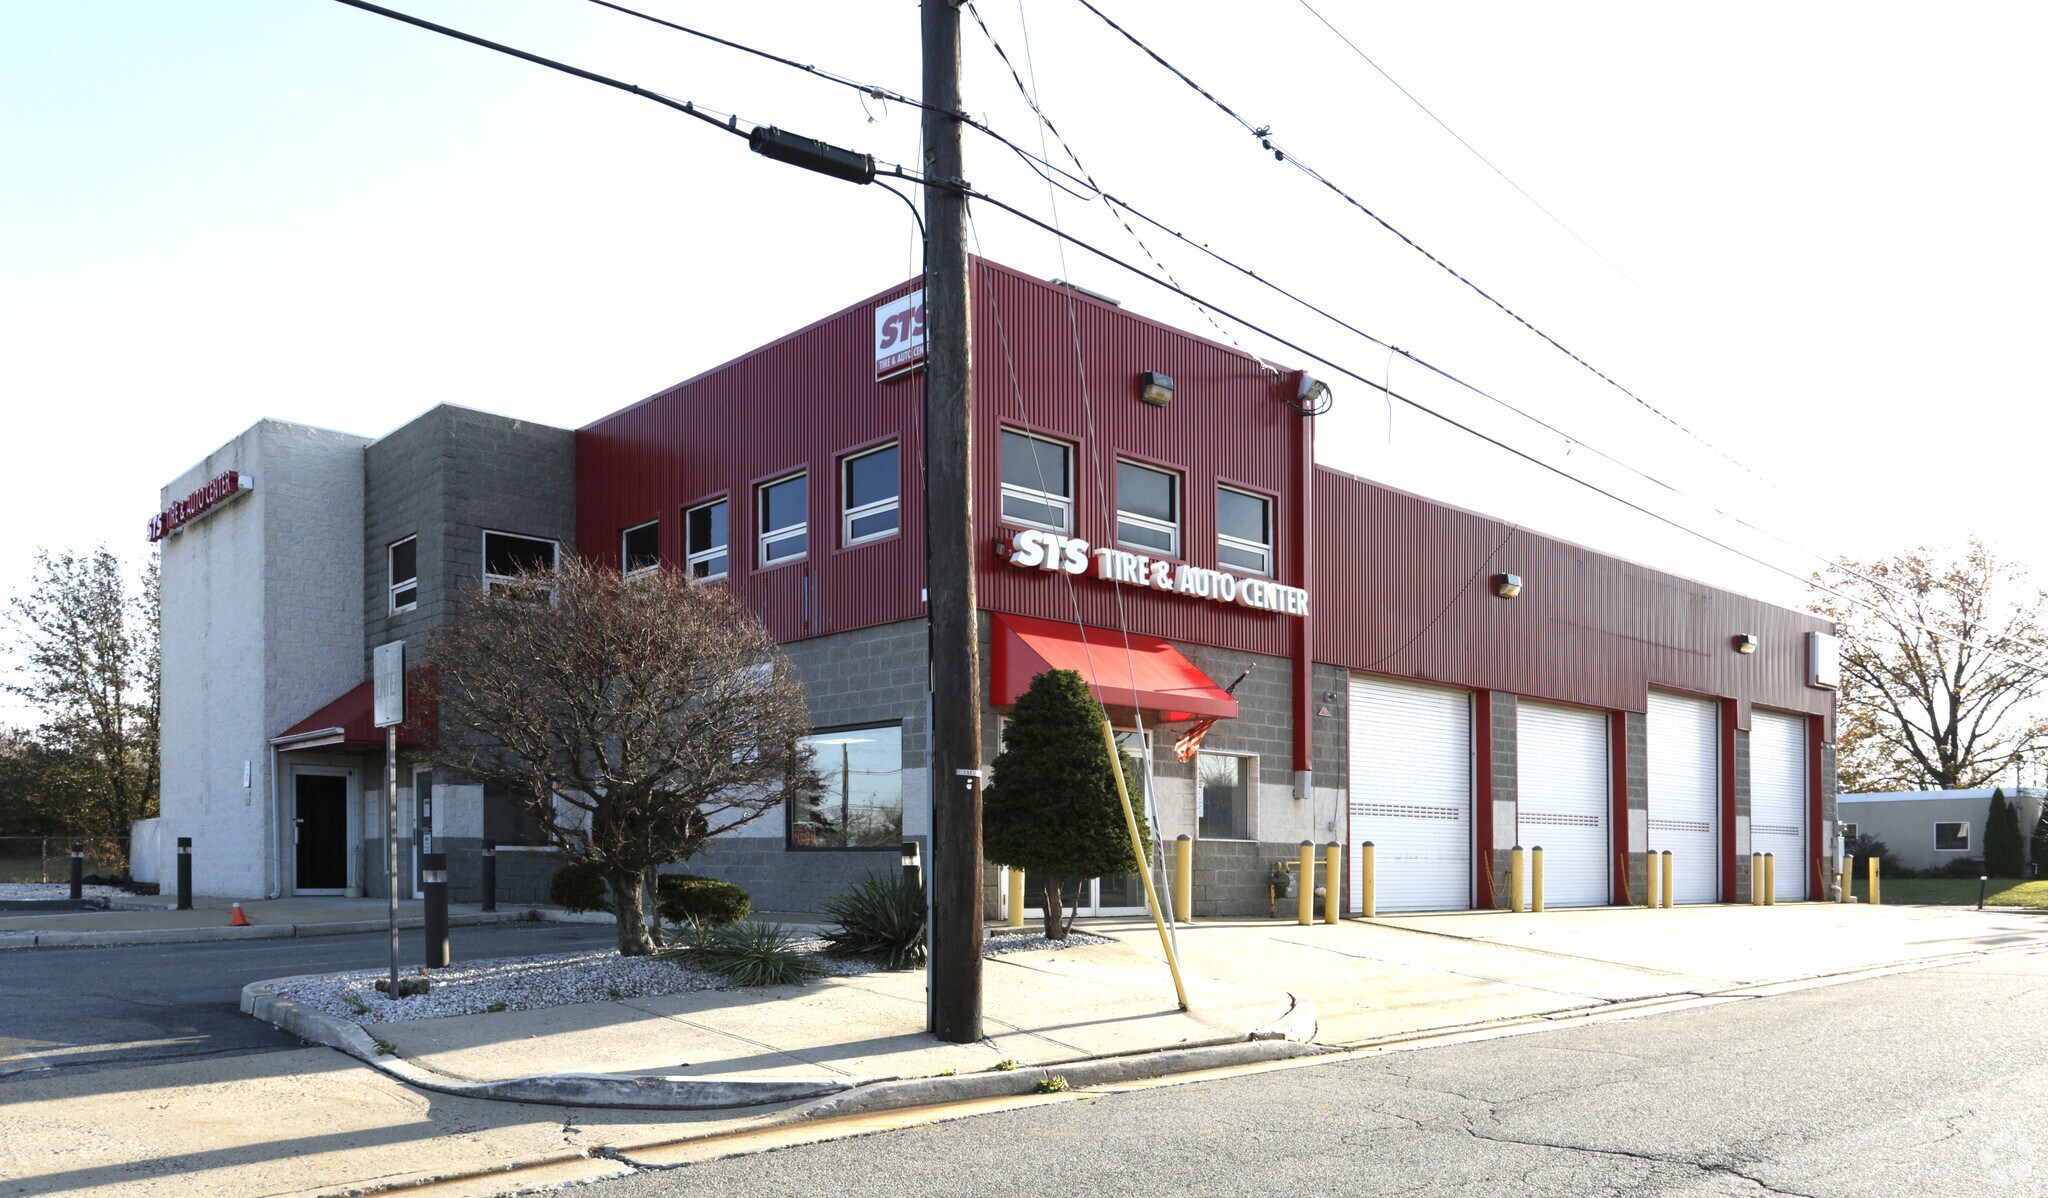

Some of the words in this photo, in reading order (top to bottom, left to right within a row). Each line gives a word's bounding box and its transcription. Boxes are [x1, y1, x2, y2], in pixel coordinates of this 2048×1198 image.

[880, 303, 930, 349] STS
[879, 357, 891, 370] TIRE
[146, 512, 163, 542] STS
[166, 501, 179, 529] TIRE
[187, 487, 205, 514] AUTO
[205, 470, 231, 504] CENTER
[1010, 529, 1090, 575] STS
[1095, 548, 1151, 587] TIRE
[1151, 560, 1174, 591] &
[1174, 564, 1237, 602] AUTO
[1236, 578, 1309, 617] CENTER
